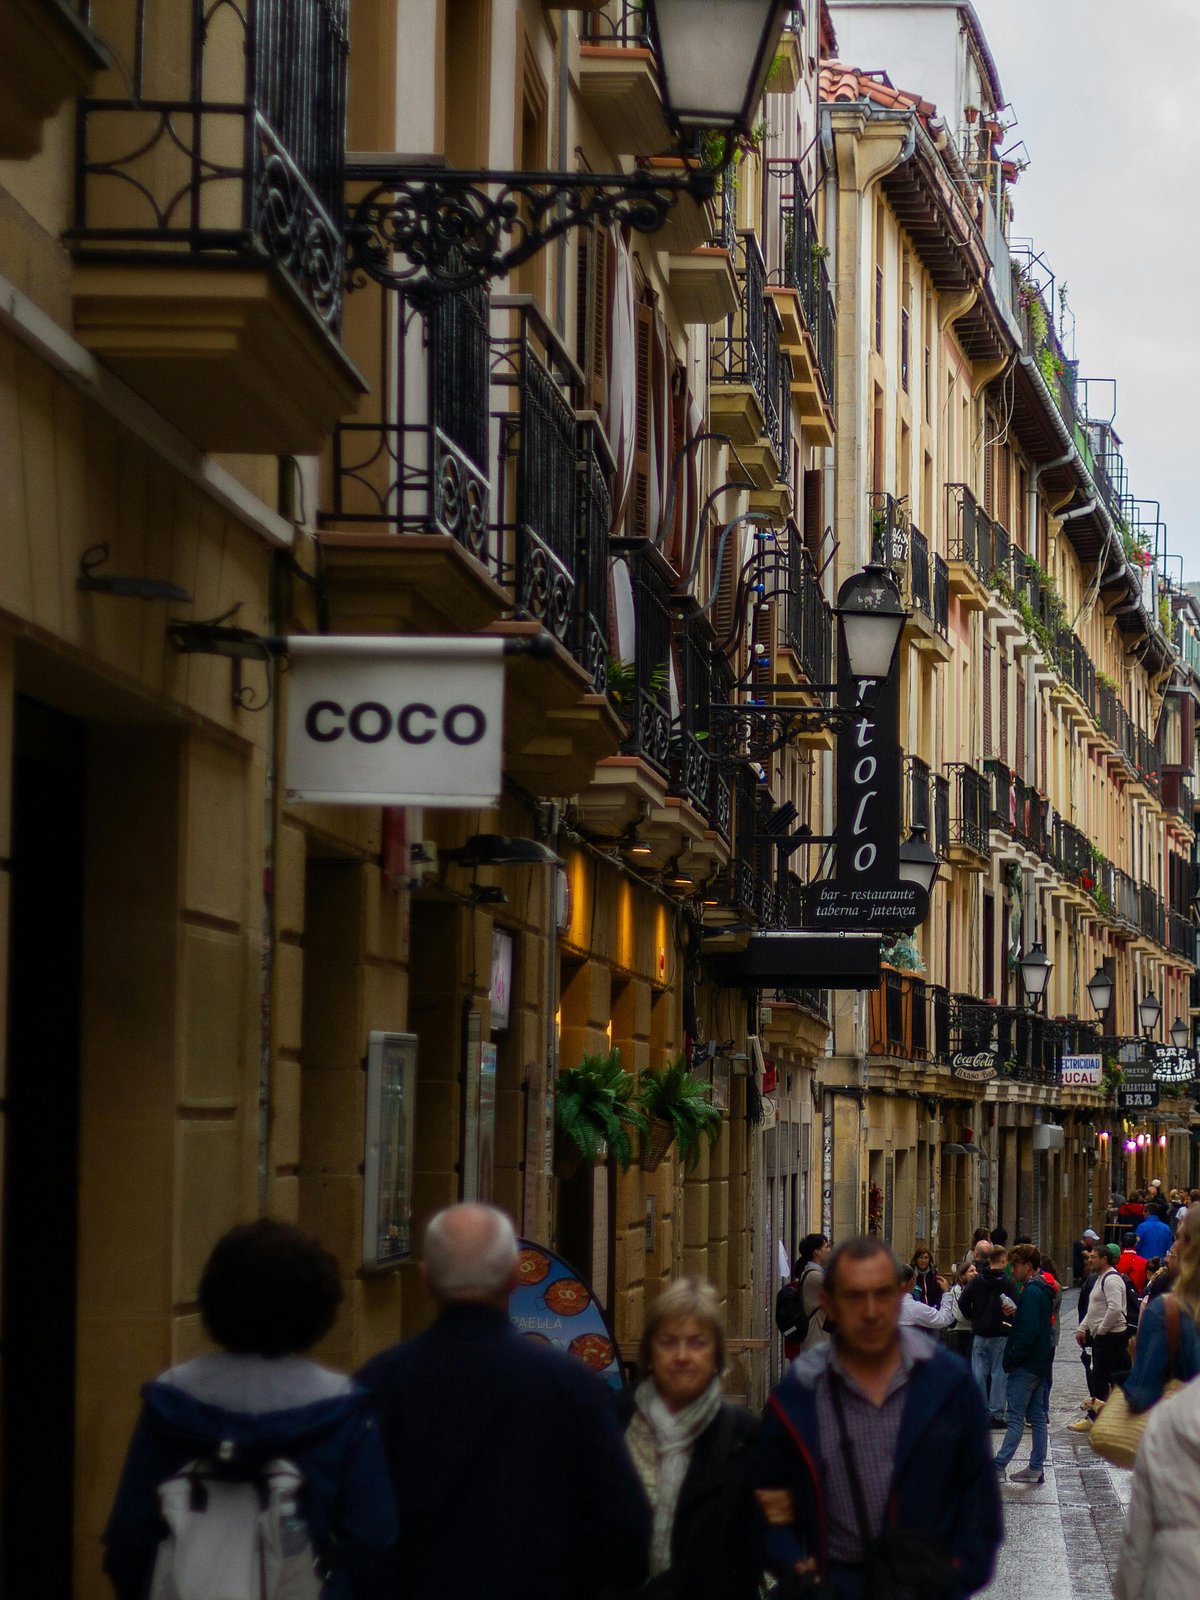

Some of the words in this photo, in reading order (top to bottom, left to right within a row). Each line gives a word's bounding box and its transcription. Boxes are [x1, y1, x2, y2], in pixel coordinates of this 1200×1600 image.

[305, 700, 487, 746] COCO
[820, 887, 840, 901] bar
[850, 887, 915, 901] restaurante
[816, 903, 859, 916] taberna
[867, 904, 917, 920] jatetxea
[1156, 1047, 1188, 1057] BAR
[1152, 1071, 1196, 1083] ESTAURANT
[1125, 1094, 1153, 1106] BAR
[510, 1316, 563, 1329] PAELLA
